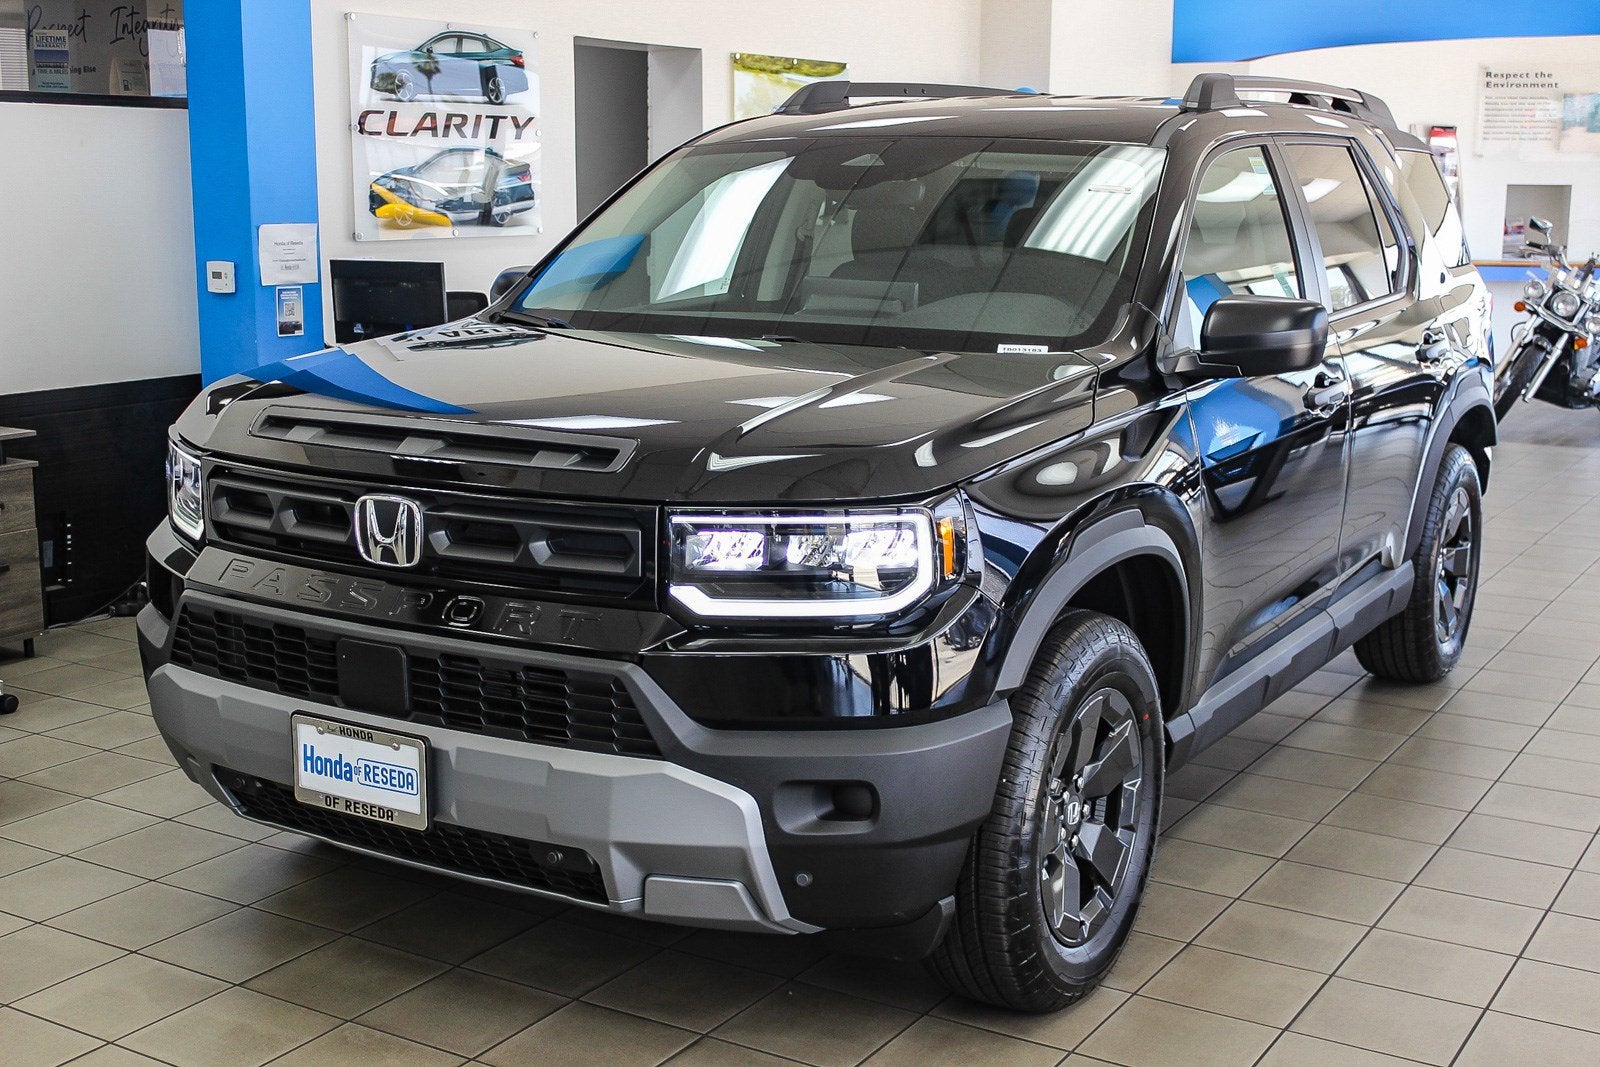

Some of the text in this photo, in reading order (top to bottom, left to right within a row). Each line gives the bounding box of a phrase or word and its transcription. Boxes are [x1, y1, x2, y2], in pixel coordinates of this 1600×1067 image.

[35, 35, 67, 43] LIFETIME
[83, 65, 97, 73] Else
[1485, 71, 1553, 80] Respect the
[1485, 81, 1559, 89] Environment
[357, 109, 535, 140] CLARITY
[217, 557, 604, 641] PASSPORT
[339, 726, 374, 742] HONDA
[303, 743, 414, 791] Honda OF RESEDA
[324, 795, 394, 821] OF RESEDA
